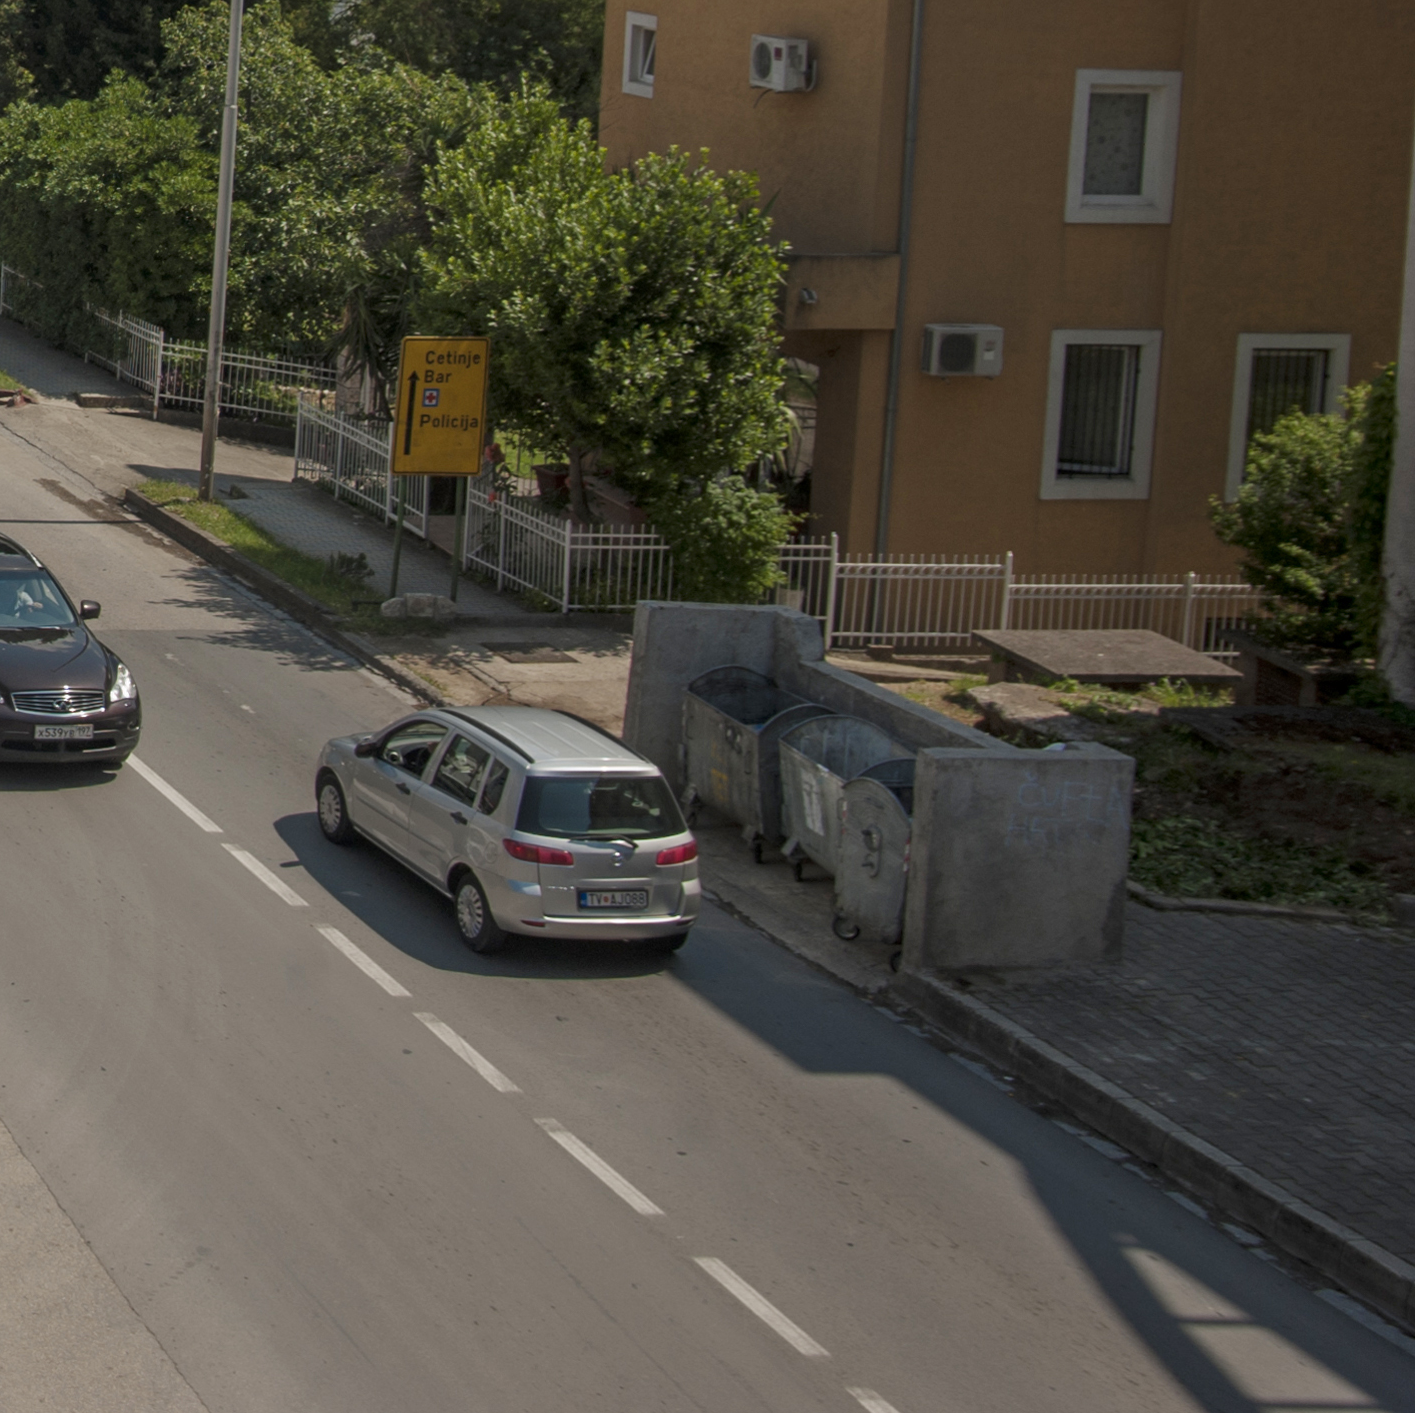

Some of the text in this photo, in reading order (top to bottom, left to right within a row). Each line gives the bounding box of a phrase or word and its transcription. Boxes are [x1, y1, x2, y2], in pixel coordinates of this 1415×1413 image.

[425, 350, 481, 368] Cetinje
[424, 369, 452, 384] Bar
[419, 414, 479, 431] Policija
